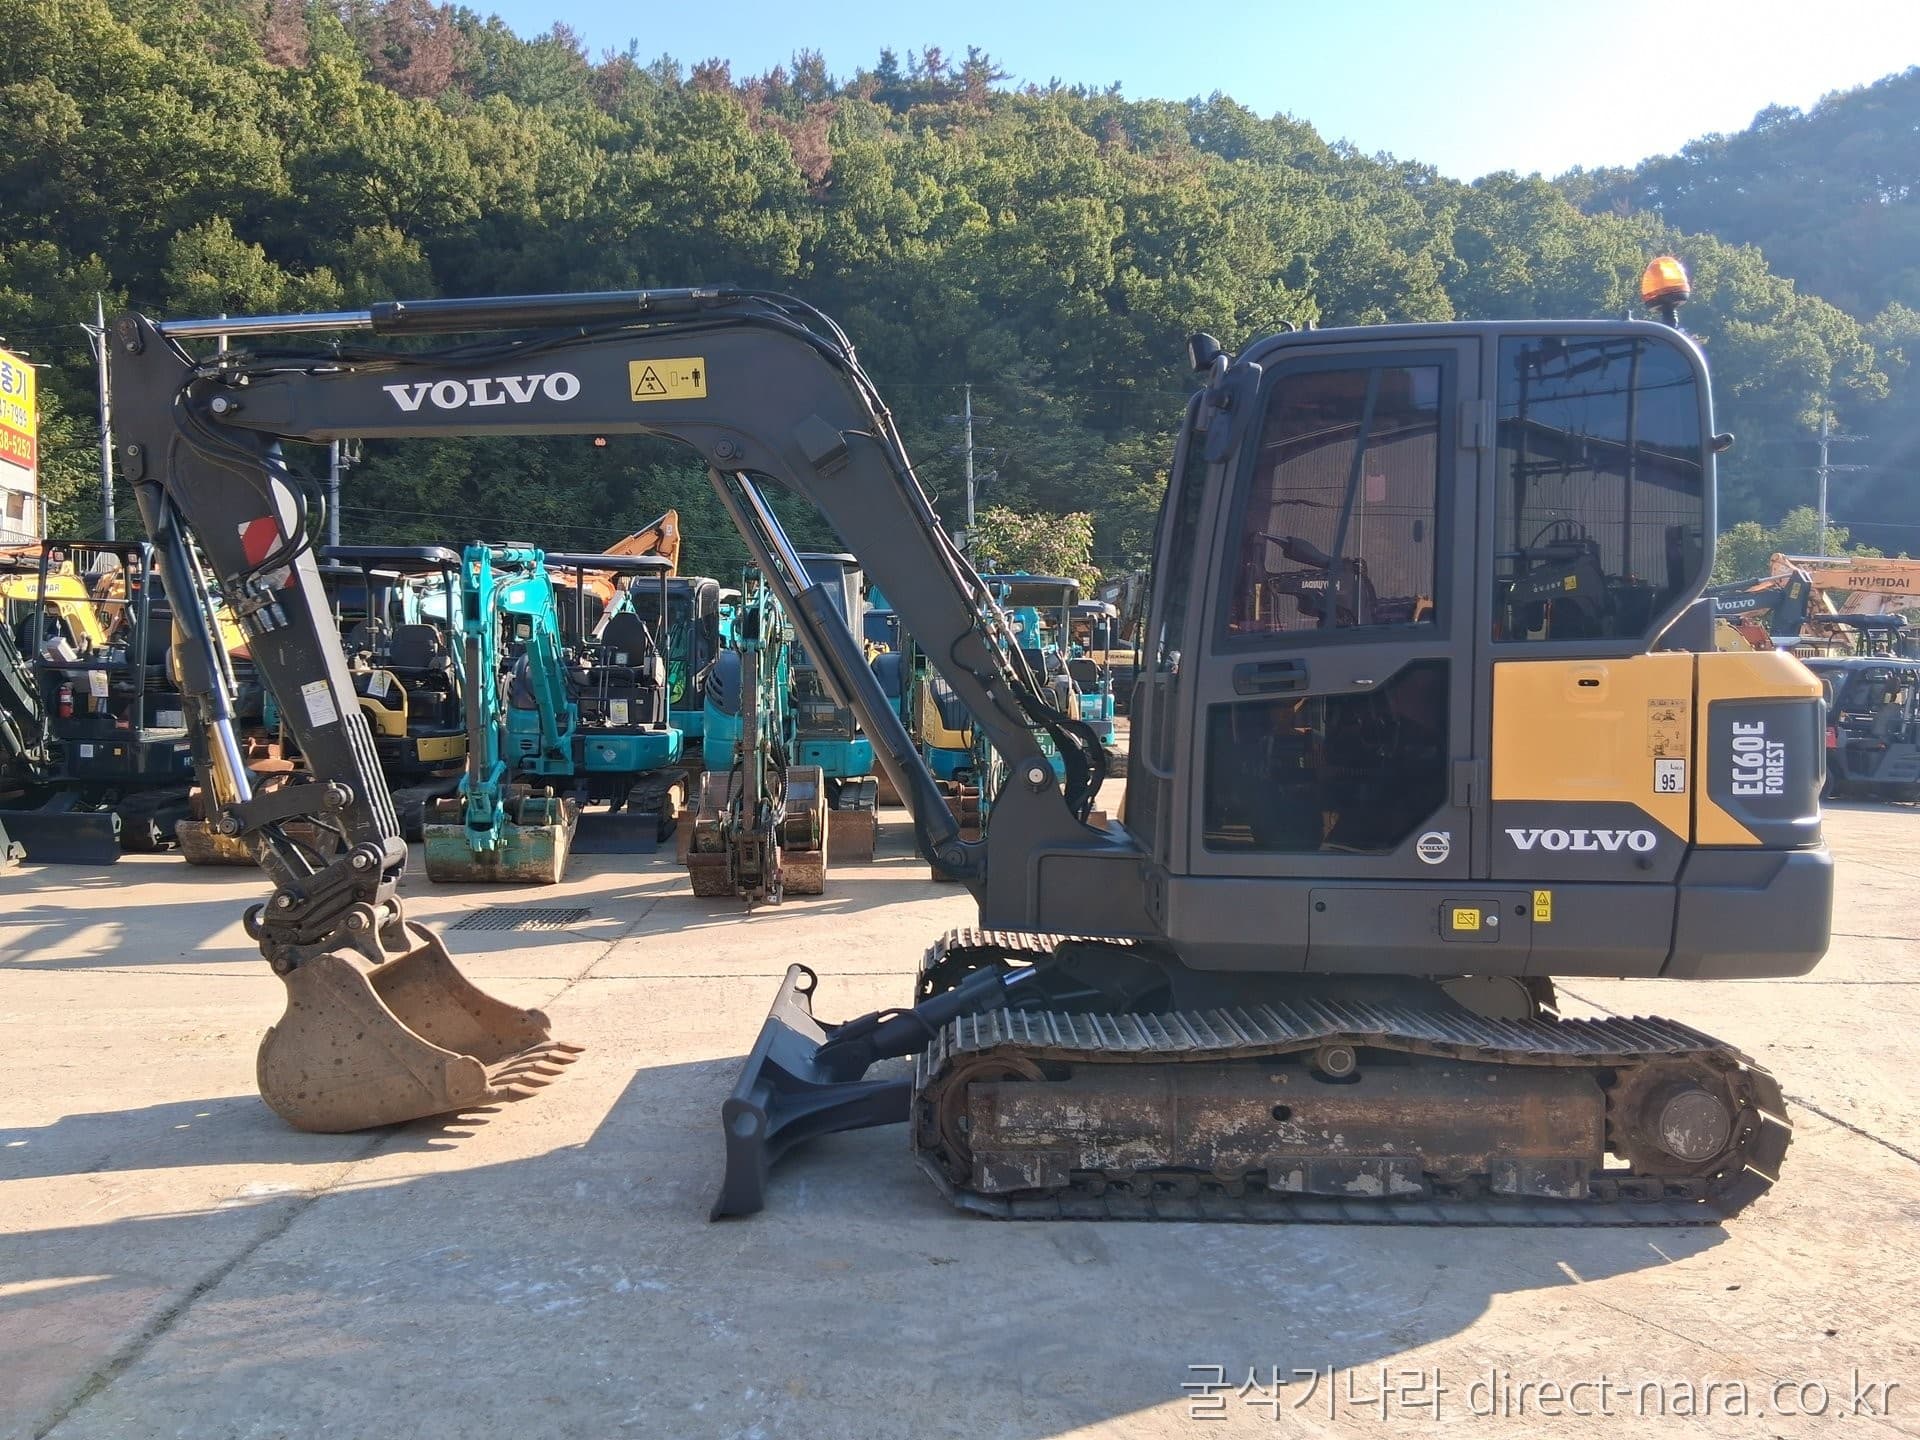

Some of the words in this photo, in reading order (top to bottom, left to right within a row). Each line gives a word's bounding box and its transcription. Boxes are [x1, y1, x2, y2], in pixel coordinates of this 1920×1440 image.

[383, 372, 581, 411] VOLVO
[1716, 599, 1756, 610] VOLVO
[1732, 721, 1765, 795] EC60E
[1765, 740, 1785, 794] FOREST
[1661, 773, 1676, 791] 95
[1505, 828, 1657, 852] VOLVO
